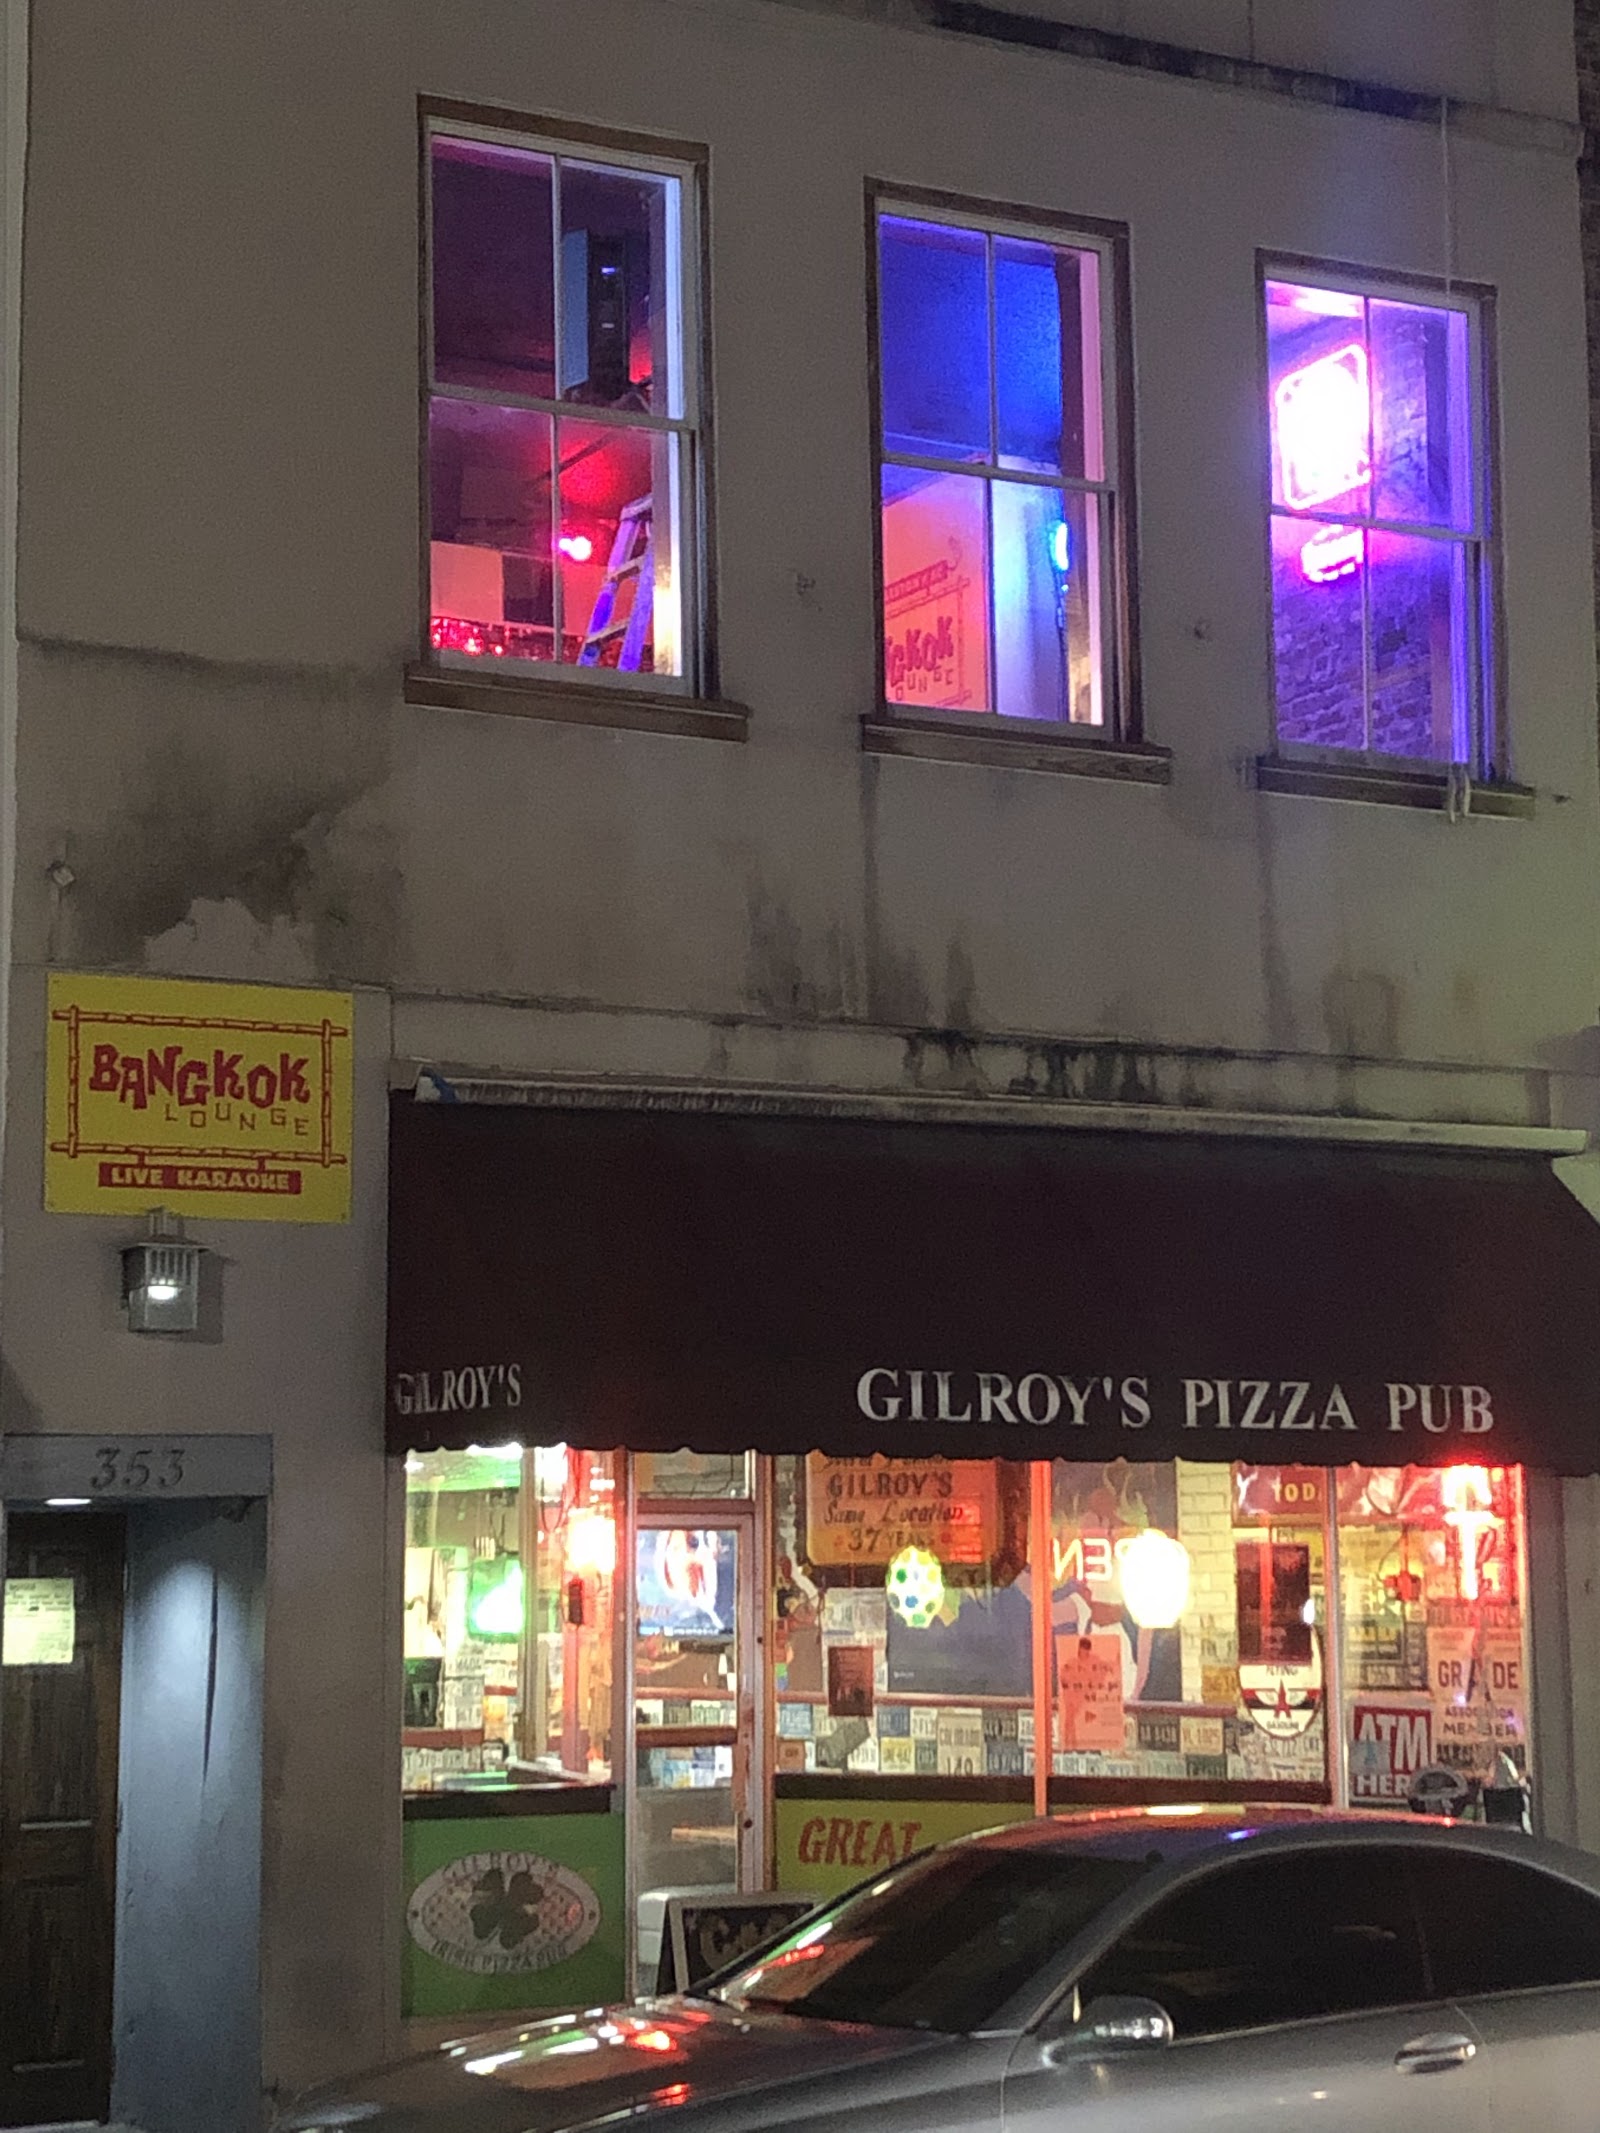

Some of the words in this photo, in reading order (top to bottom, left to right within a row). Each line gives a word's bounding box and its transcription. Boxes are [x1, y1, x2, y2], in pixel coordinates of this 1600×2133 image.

[89, 1043, 311, 1110] BANGKOK
[164, 1102, 310, 1137] LOUNGE
[111, 1165, 164, 1186] LIVE
[177, 1168, 290, 1190] KARAOKE
[394, 1362, 521, 1415] GILROY'S
[856, 1367, 1151, 1429] GILROY'S
[1181, 1378, 1359, 1431] PIZZA
[1385, 1382, 1495, 1434] PUB
[90, 1447, 187, 1489] 353
[826, 1469, 954, 1499] GILROY'S
[823, 1500, 867, 1525] Same
[846, 1527, 882, 1553] 37
[1357, 1712, 1430, 1772] ATM
[1357, 1773, 1410, 1797] HER
[797, 1815, 922, 1868] GREAT
